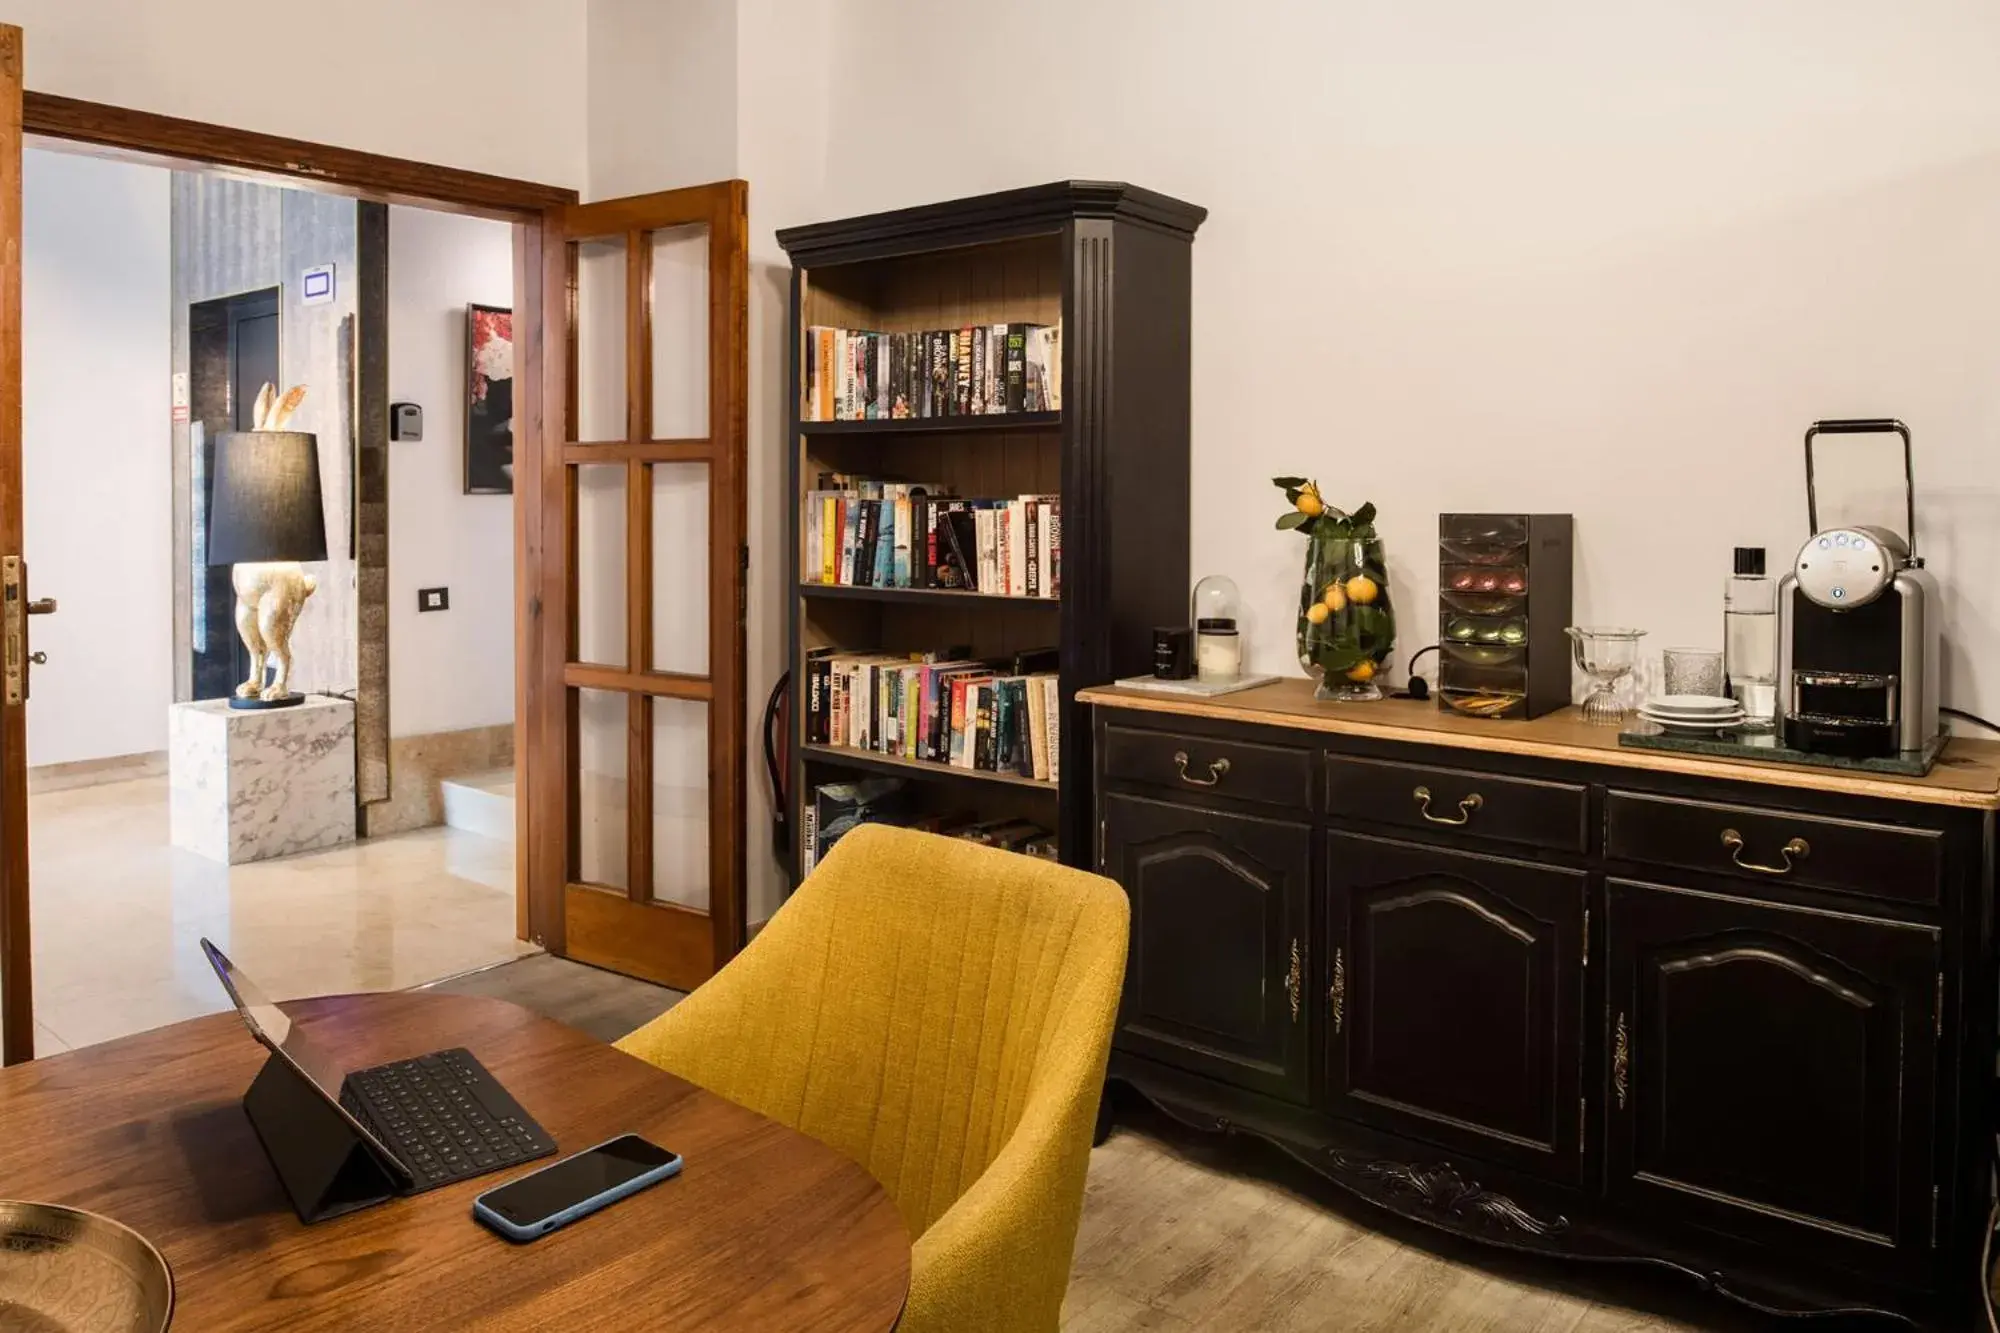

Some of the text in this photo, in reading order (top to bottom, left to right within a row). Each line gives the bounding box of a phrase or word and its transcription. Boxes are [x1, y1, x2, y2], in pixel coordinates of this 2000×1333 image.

[933, 338, 943, 372] BROWN
[959, 336, 971, 388] HARVEY
[1050, 515, 1060, 549] BROWN
